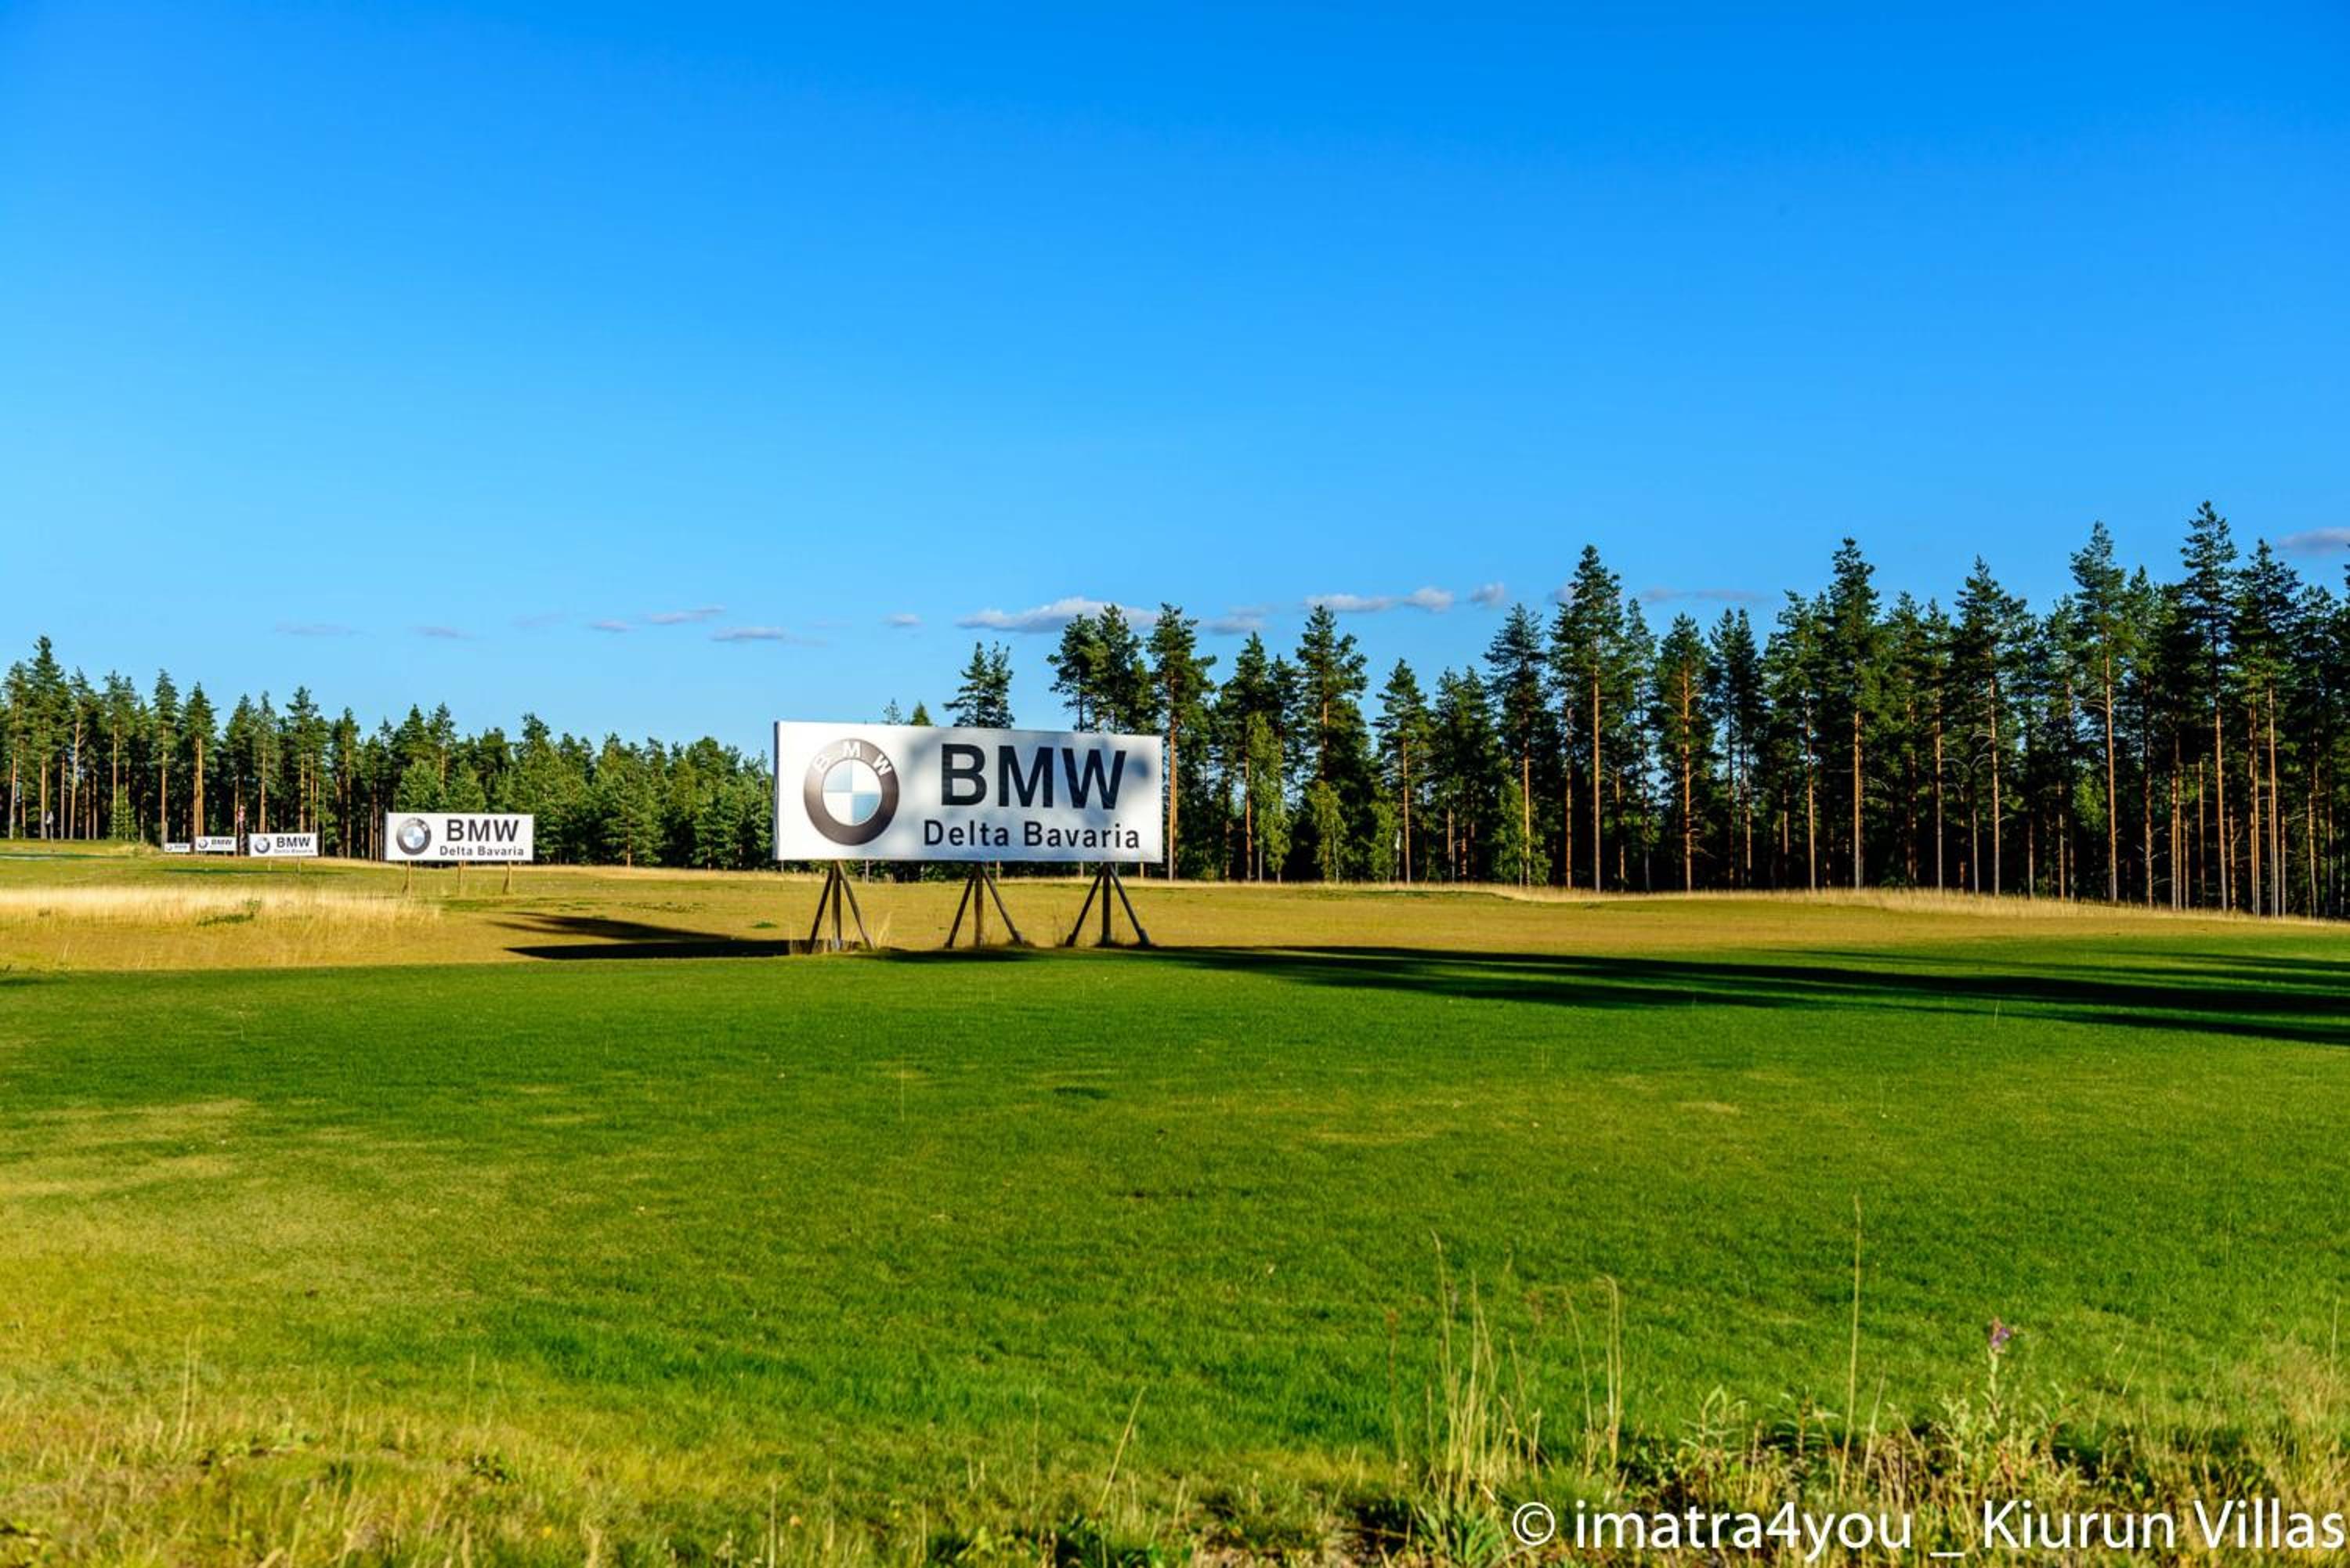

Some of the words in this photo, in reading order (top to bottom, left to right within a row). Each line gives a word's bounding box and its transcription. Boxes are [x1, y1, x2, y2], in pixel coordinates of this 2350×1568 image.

[813, 741, 892, 776] BMW
[941, 743, 1127, 810] BMW
[277, 836, 311, 848] BMW
[447, 818, 519, 842] BMW
[924, 819, 1009, 847] Delta
[1024, 821, 1140, 849] Bavaria
[439, 845, 472, 856] Delta
[477, 845, 524, 856] Bavaria
